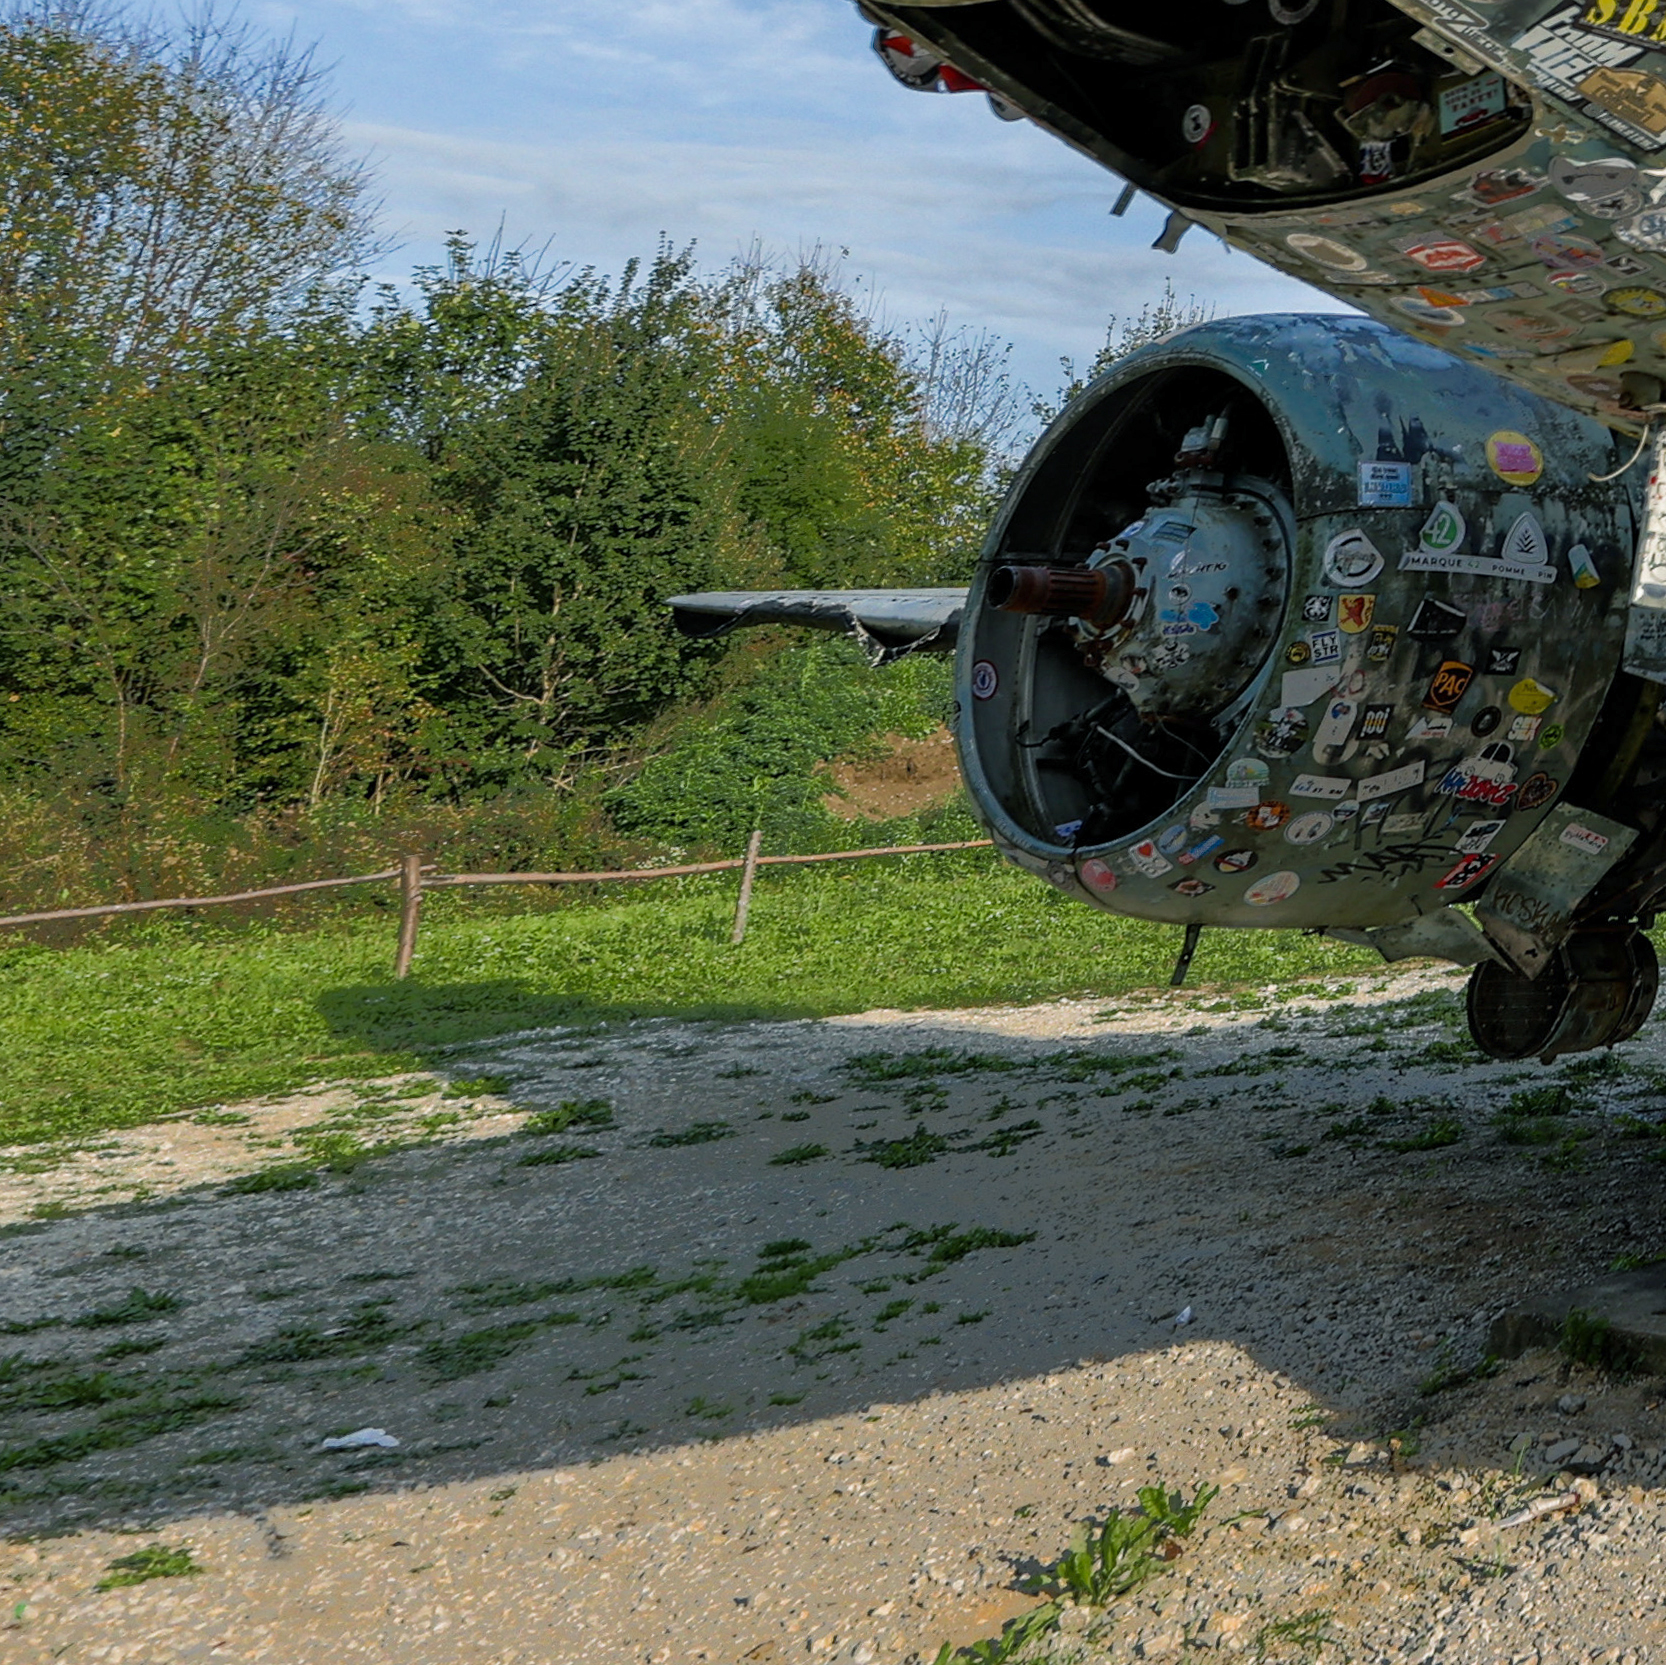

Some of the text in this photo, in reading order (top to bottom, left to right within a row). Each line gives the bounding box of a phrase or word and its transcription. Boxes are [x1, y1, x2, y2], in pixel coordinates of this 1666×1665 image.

[1422, 514, 1456, 549] 42
[1411, 555, 1463, 572] MARQUE
[1490, 564, 1526, 577] POMME
[1311, 635, 1337, 650] FLY
[1313, 644, 1339, 659] STR
[1436, 671, 1466, 697] PAC
